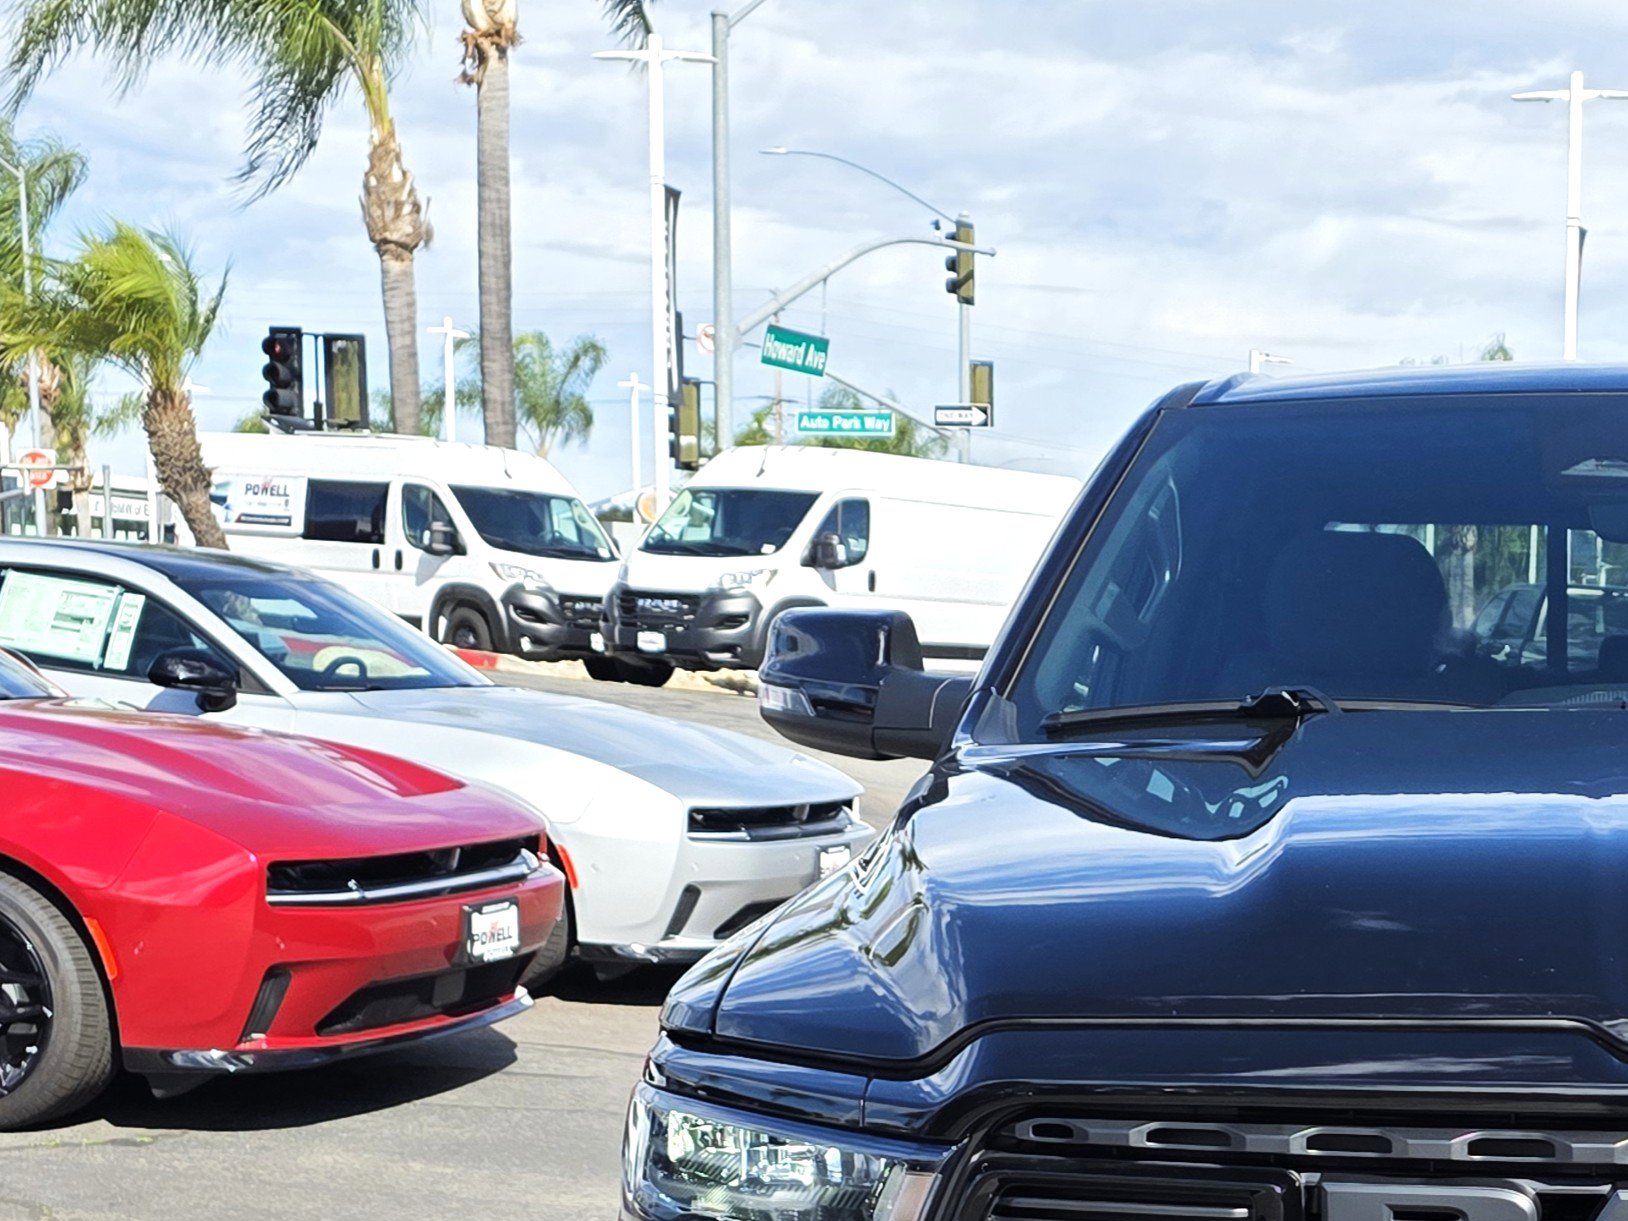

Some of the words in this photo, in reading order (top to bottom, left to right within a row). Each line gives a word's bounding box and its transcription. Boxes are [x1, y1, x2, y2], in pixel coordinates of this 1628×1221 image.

[763, 332, 806, 366] Howard
[804, 343, 826, 370] Ave
[800, 415, 830, 429] Auto
[832, 415, 861, 429] Park
[863, 416, 890, 432] Way
[244, 483, 290, 497] POWELL
[472, 926, 513, 946] POWELL
